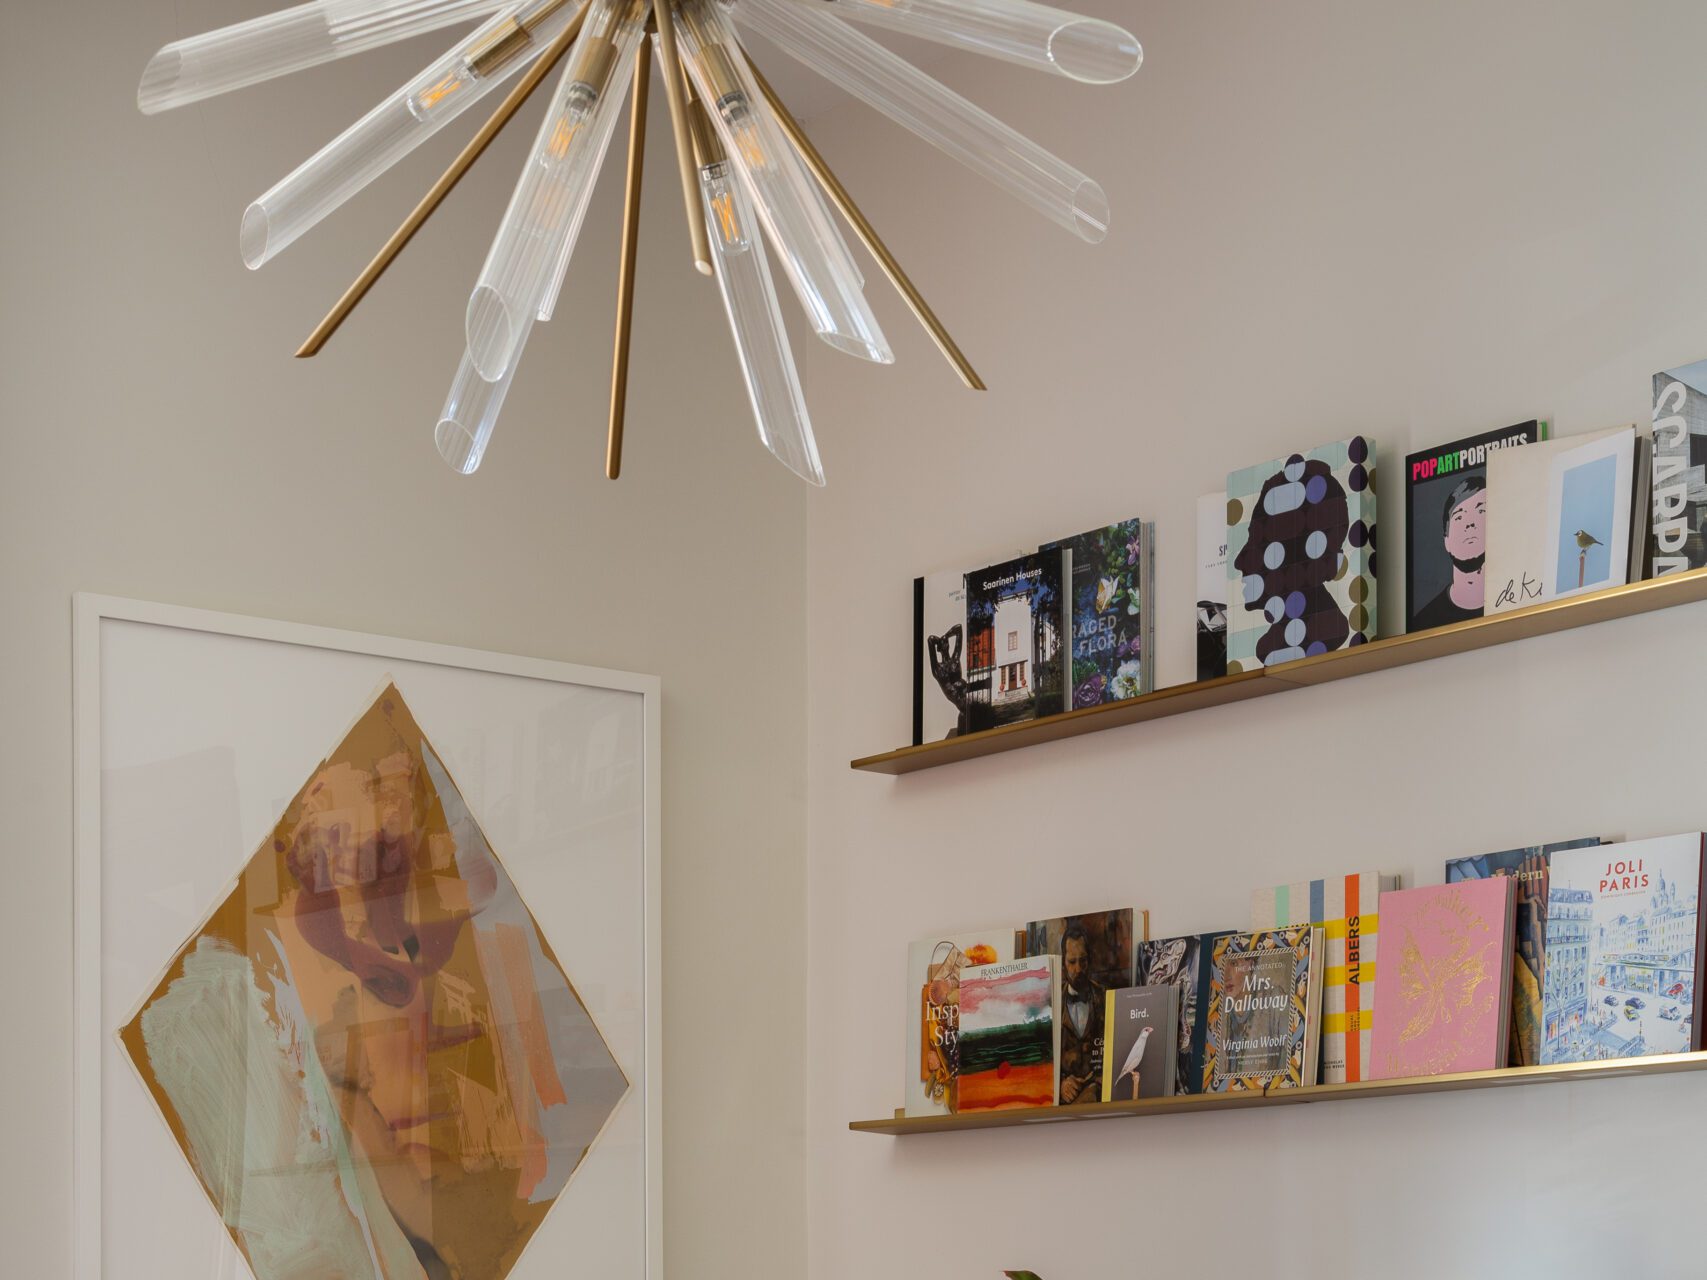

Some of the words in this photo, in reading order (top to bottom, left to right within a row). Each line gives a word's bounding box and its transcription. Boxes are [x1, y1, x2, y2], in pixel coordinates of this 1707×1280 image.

[982, 575, 1014, 591] Saarinen
[1015, 568, 1042, 581] Houses
[1079, 628, 1127, 656] FLORA
[1605, 859, 1643, 876] JOLI
[1599, 874, 1649, 893] PARIS
[1348, 916, 1360, 985] ALBERS
[980, 962, 1028, 977] FRANKENTHALER
[1242, 974, 1274, 992] Mrs.
[1130, 1008, 1149, 1019] Bird.
[1224, 994, 1288, 1014] Dalloway
[1222, 1037, 1259, 1053] Virginia
[1260, 1034, 1287, 1047] Woolf
